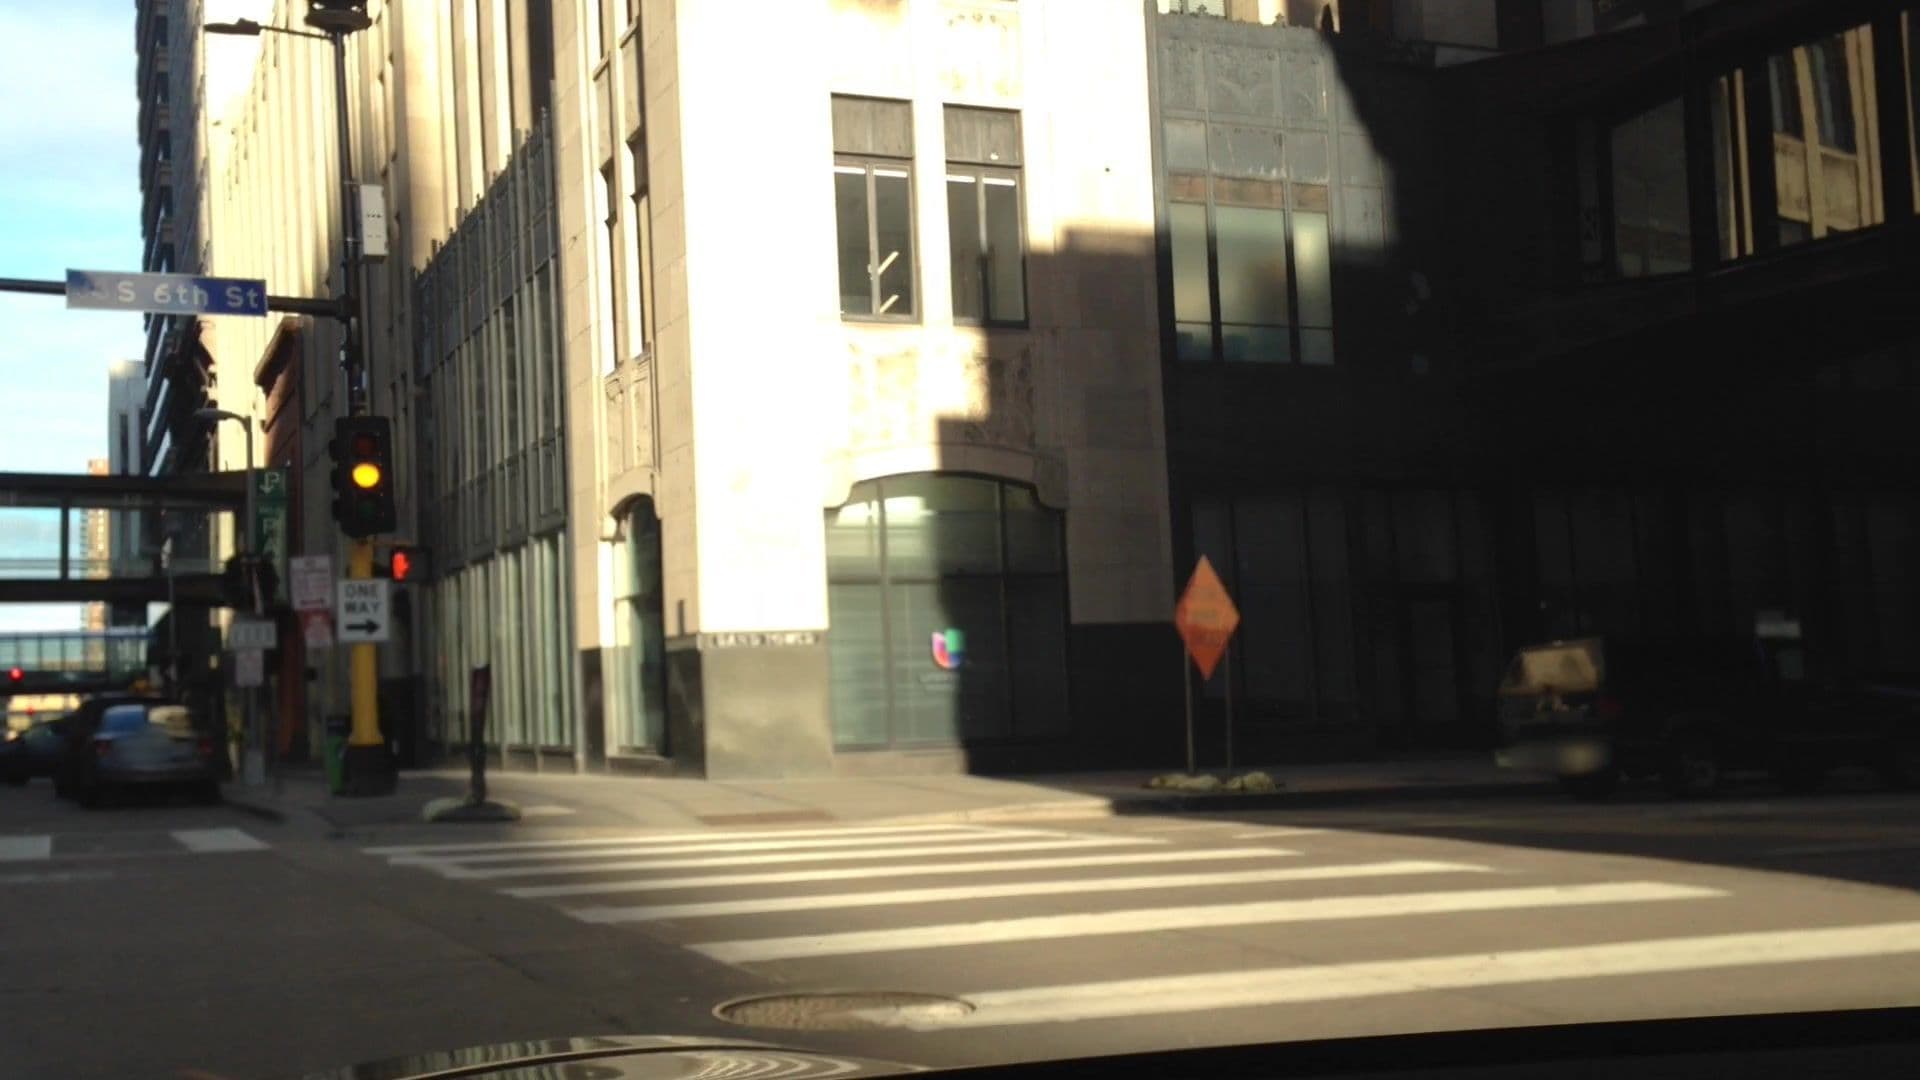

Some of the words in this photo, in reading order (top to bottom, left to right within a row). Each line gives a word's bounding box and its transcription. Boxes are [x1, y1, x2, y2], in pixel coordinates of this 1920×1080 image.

[118, 281, 135, 302] S
[153, 283, 208, 307] 6th
[225, 286, 259, 308] St
[345, 583, 378, 599] ONE
[344, 601, 381, 615] WAY
